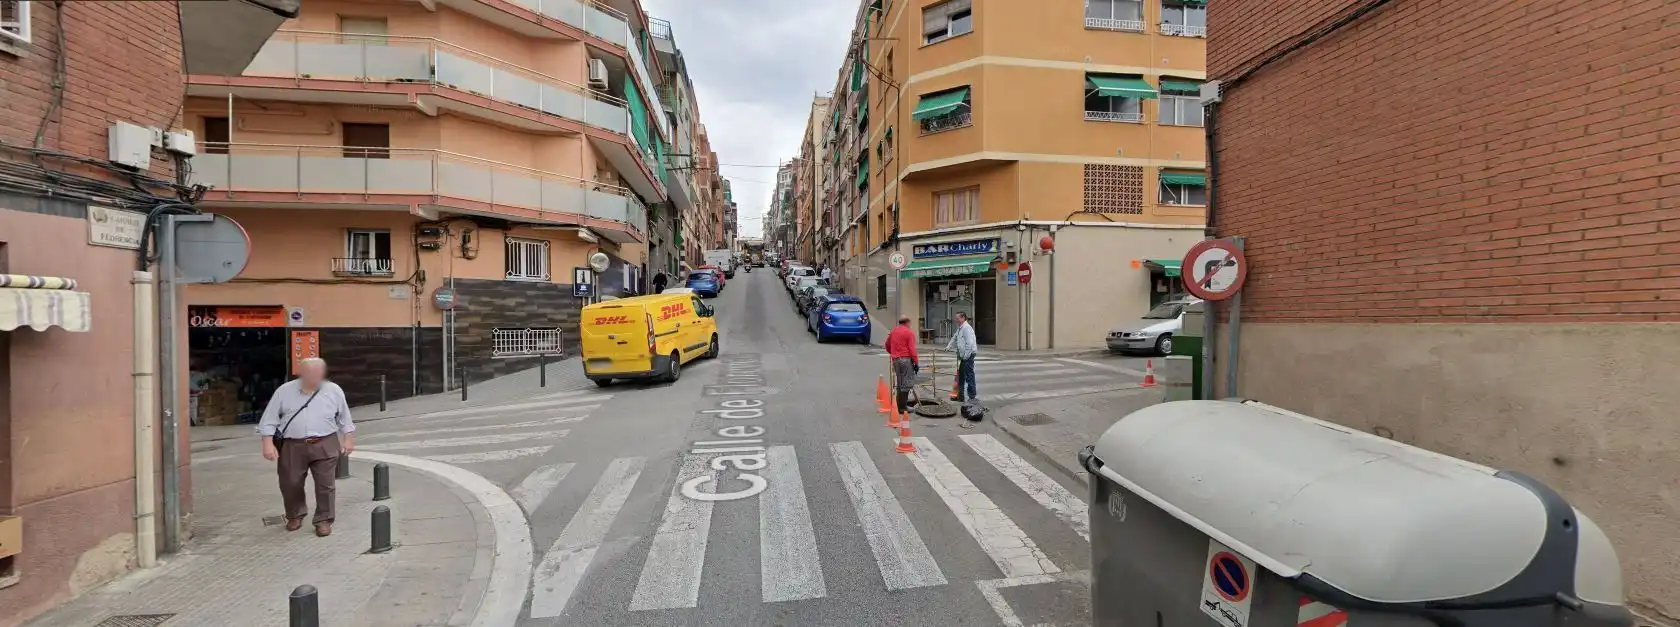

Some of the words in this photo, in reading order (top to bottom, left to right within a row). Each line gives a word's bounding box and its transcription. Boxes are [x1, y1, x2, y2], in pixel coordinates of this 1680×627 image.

[914, 244, 949, 254] BAR
[950, 241, 987, 251] Charly
[893, 256, 902, 264] 40
[660, 303, 687, 320] DHL
[190, 315, 232, 328] Oscar
[595, 315, 628, 326] DHL
